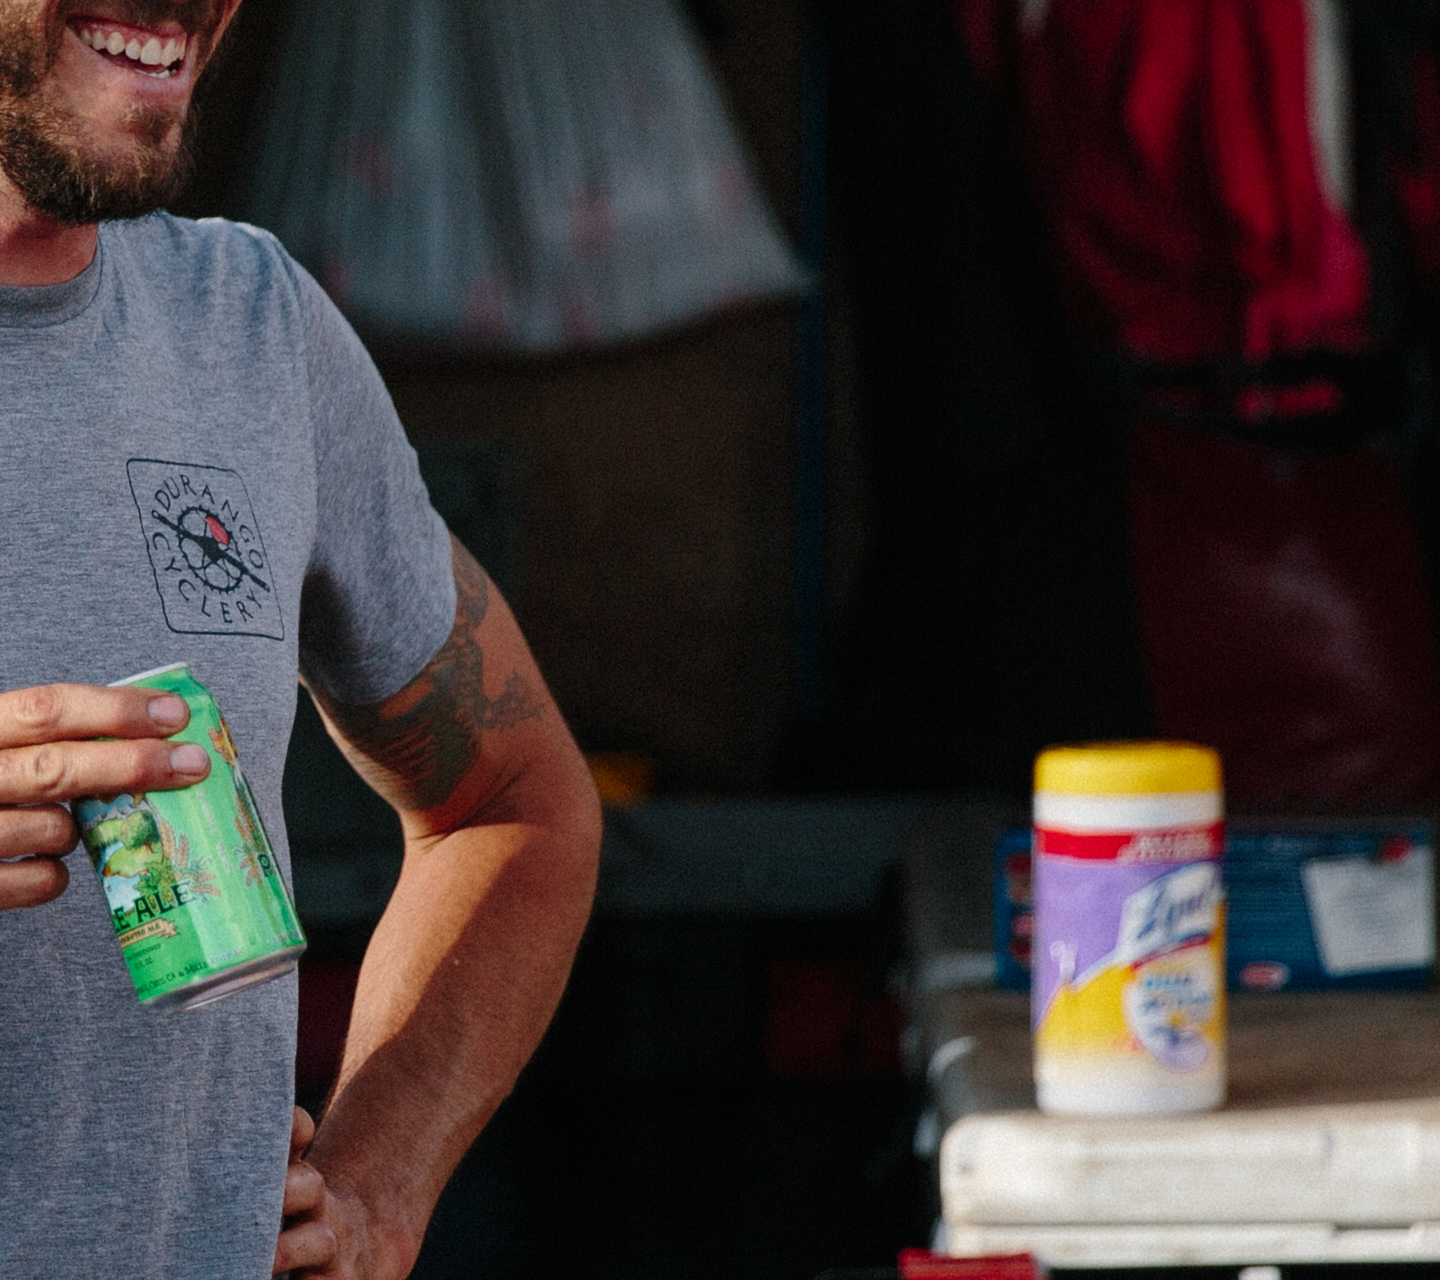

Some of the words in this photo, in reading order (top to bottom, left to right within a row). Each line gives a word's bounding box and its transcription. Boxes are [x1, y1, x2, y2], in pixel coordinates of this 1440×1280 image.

[154, 474, 264, 569] DURANGO
[152, 531, 262, 624] CYCLERY
[133, 879, 197, 924] ALE
